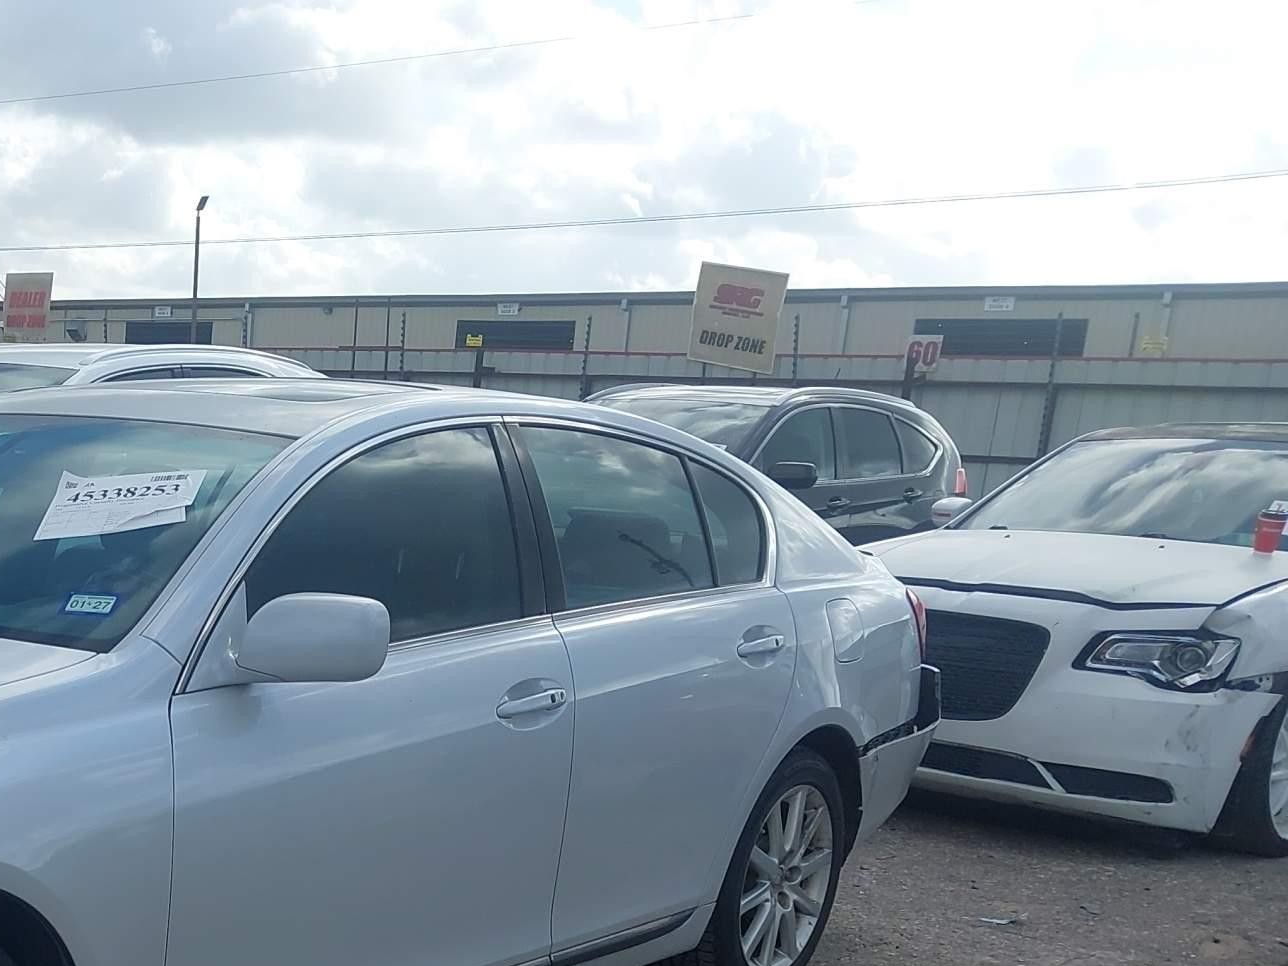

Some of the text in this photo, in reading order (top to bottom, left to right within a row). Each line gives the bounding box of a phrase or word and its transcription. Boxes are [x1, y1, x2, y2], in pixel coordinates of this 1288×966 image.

[699, 329, 767, 354] DROP ZONE
[908, 340, 939, 367] 60
[67, 483, 180, 503] 45338253
